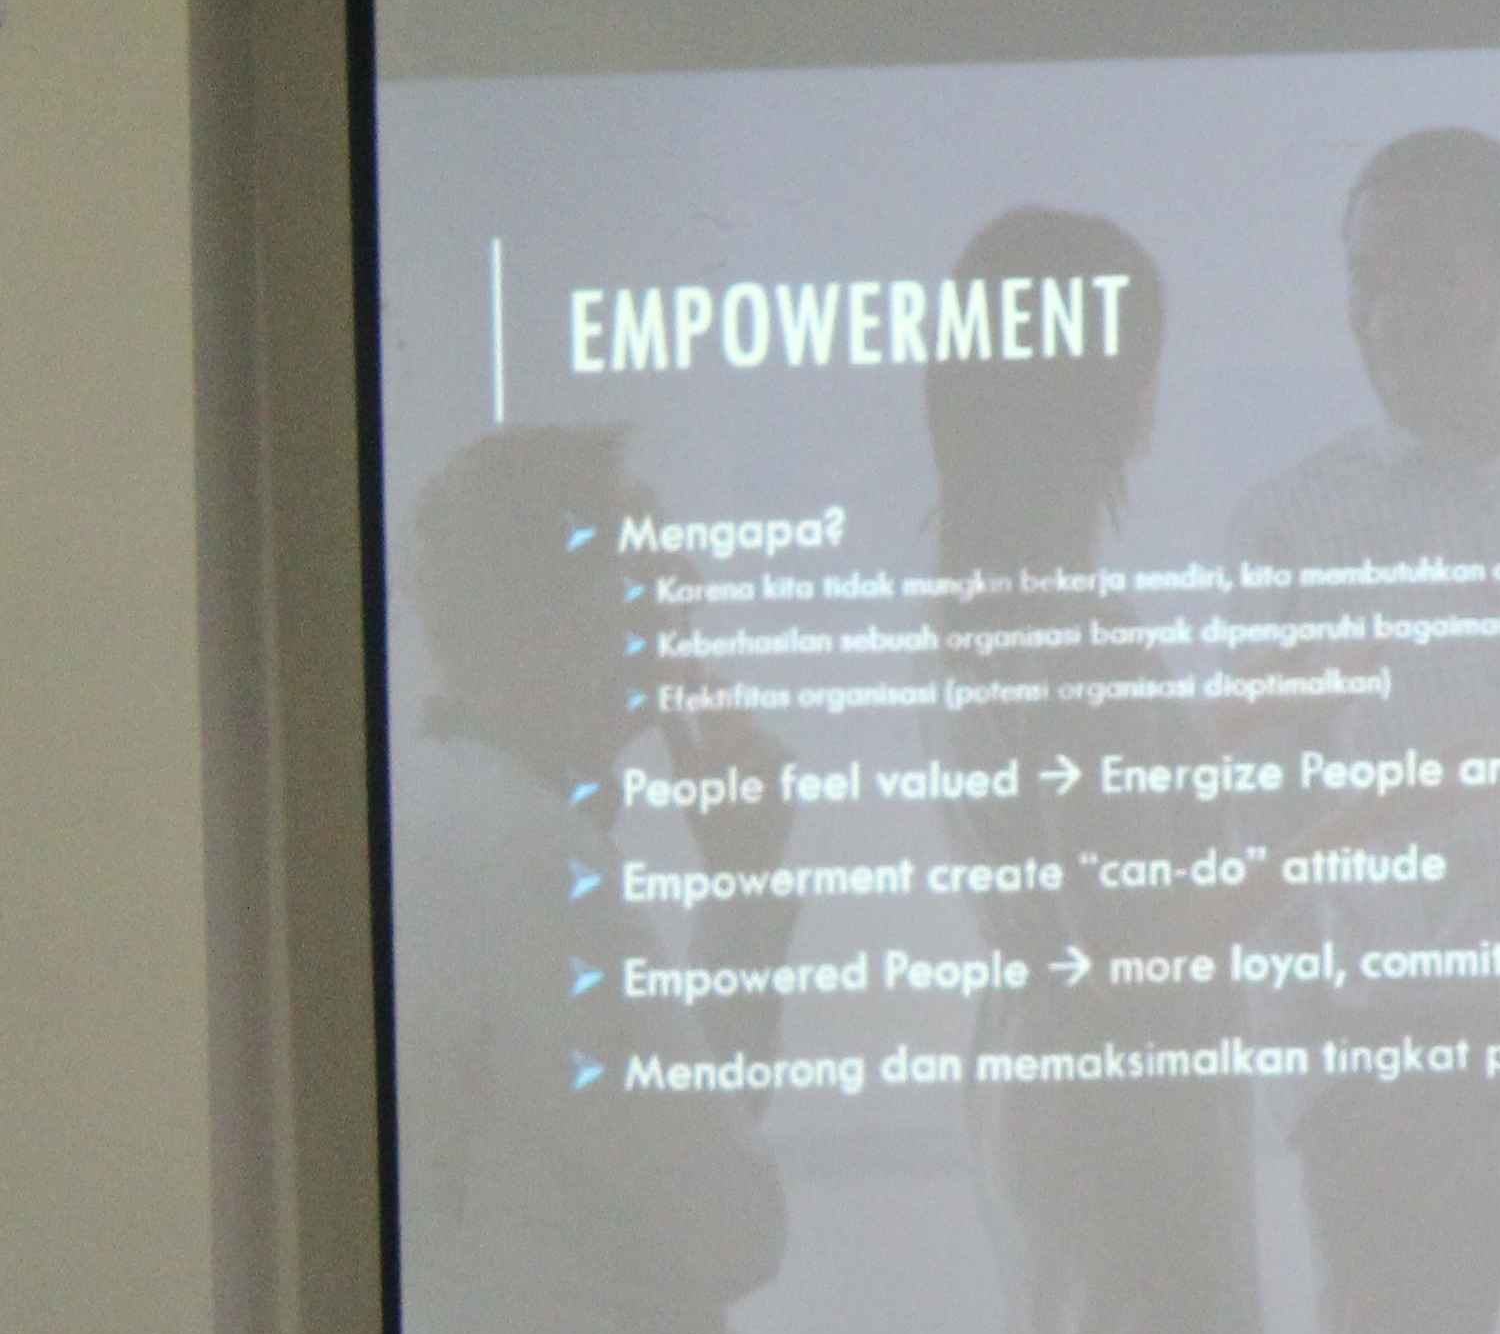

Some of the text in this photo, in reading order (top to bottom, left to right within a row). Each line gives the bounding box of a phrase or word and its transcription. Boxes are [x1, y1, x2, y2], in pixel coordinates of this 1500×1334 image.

[570, 275, 1131, 373] EMPOWERMENT
[617, 506, 847, 557] Mengapa?
[655, 576, 757, 604] Karena
[761, 574, 813, 600] kita
[823, 572, 894, 599] tidak
[903, 570, 1011, 601] mungkin
[1020, 569, 1126, 599] bekerja
[1135, 562, 1233, 594] sendiri,
[1242, 561, 1293, 588] kita
[1300, 557, 1485, 586] membutuhkan
[657, 628, 833, 659] Keberhasilan
[840, 626, 938, 652] sebuah
[945, 624, 1080, 655] organisasi
[1089, 616, 1191, 646] banyak
[1201, 613, 1366, 649] dipengaruhi
[799, 680, 938, 711] organisasi
[944, 680, 1049, 710] (potensi
[1058, 677, 1193, 706] organisasi
[1203, 668, 1392, 703] dioptimalkan)
[622, 766, 763, 814] People
[781, 762, 860, 802] feel
[878, 759, 1020, 801] valued
[1101, 755, 1284, 799] Energize
[1300, 749, 1444, 796] People
[622, 859, 914, 908] Empowerment
[928, 859, 1062, 892] create
[1280, 844, 1448, 885] attitude
[622, 953, 868, 1006] Empowered
[886, 951, 1029, 997] People
[1110, 949, 1215, 983] more
[1230, 942, 1347, 990] loyal,
[624, 1052, 865, 1096] Mendorong
[881, 1045, 961, 1085] dan
[978, 1038, 1308, 1083] memaksimalkan
[1324, 1037, 1470, 1081] tingkat
